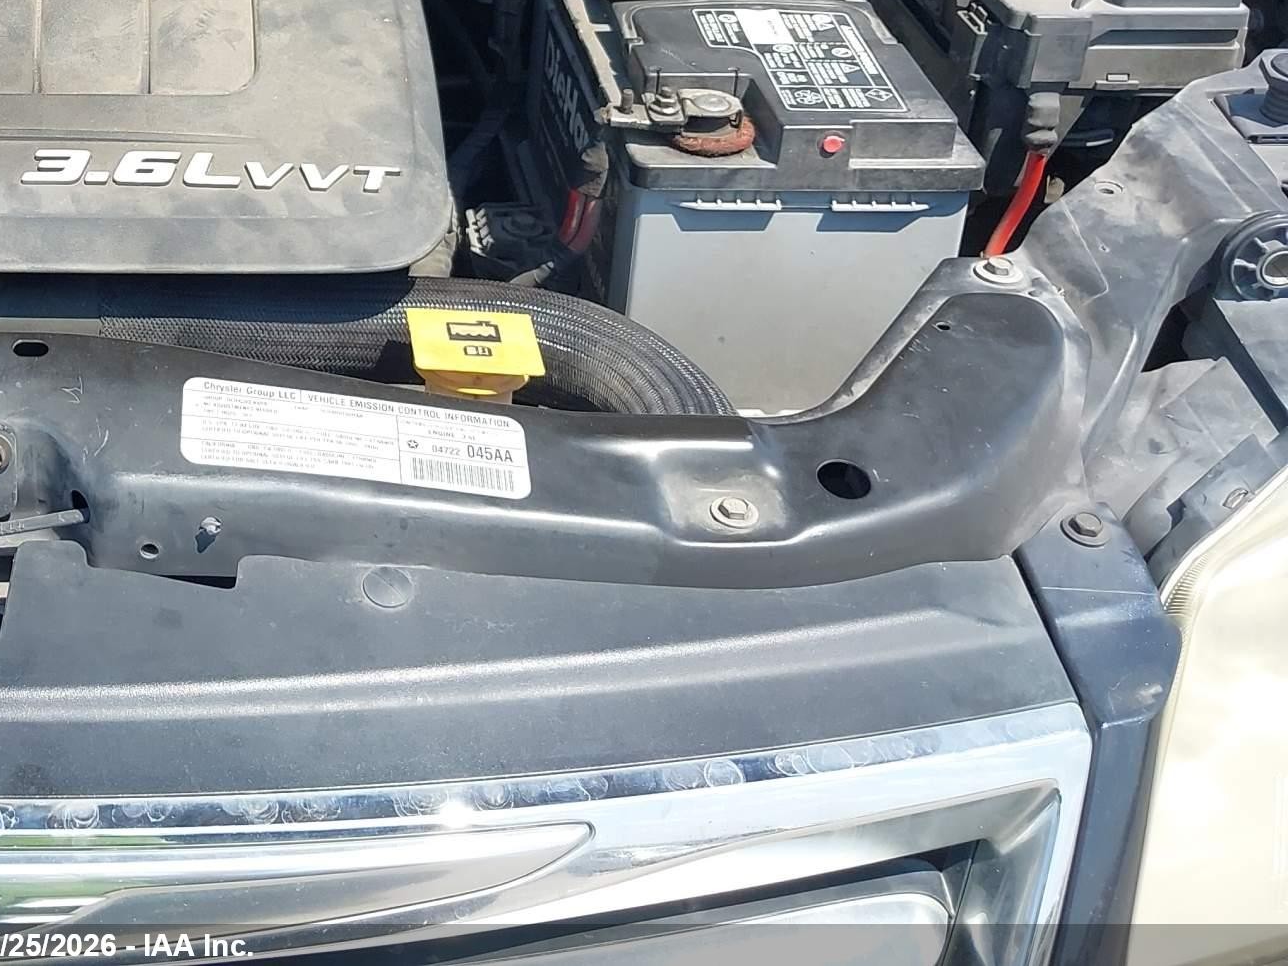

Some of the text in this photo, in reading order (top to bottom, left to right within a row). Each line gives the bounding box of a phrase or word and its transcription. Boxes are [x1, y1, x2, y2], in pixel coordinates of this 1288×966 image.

[545, 29, 589, 153] DieHa
[21, 147, 402, 194] 3.6L VVT
[203, 380, 297, 400] Chrysler Group LLC
[307, 392, 347, 408] VEHICLE
[349, 398, 395, 414] EMISSION
[398, 405, 442, 420] CONTROL
[444, 409, 510, 428] INFORMATION
[431, 443, 514, 463] 04722 045AA
